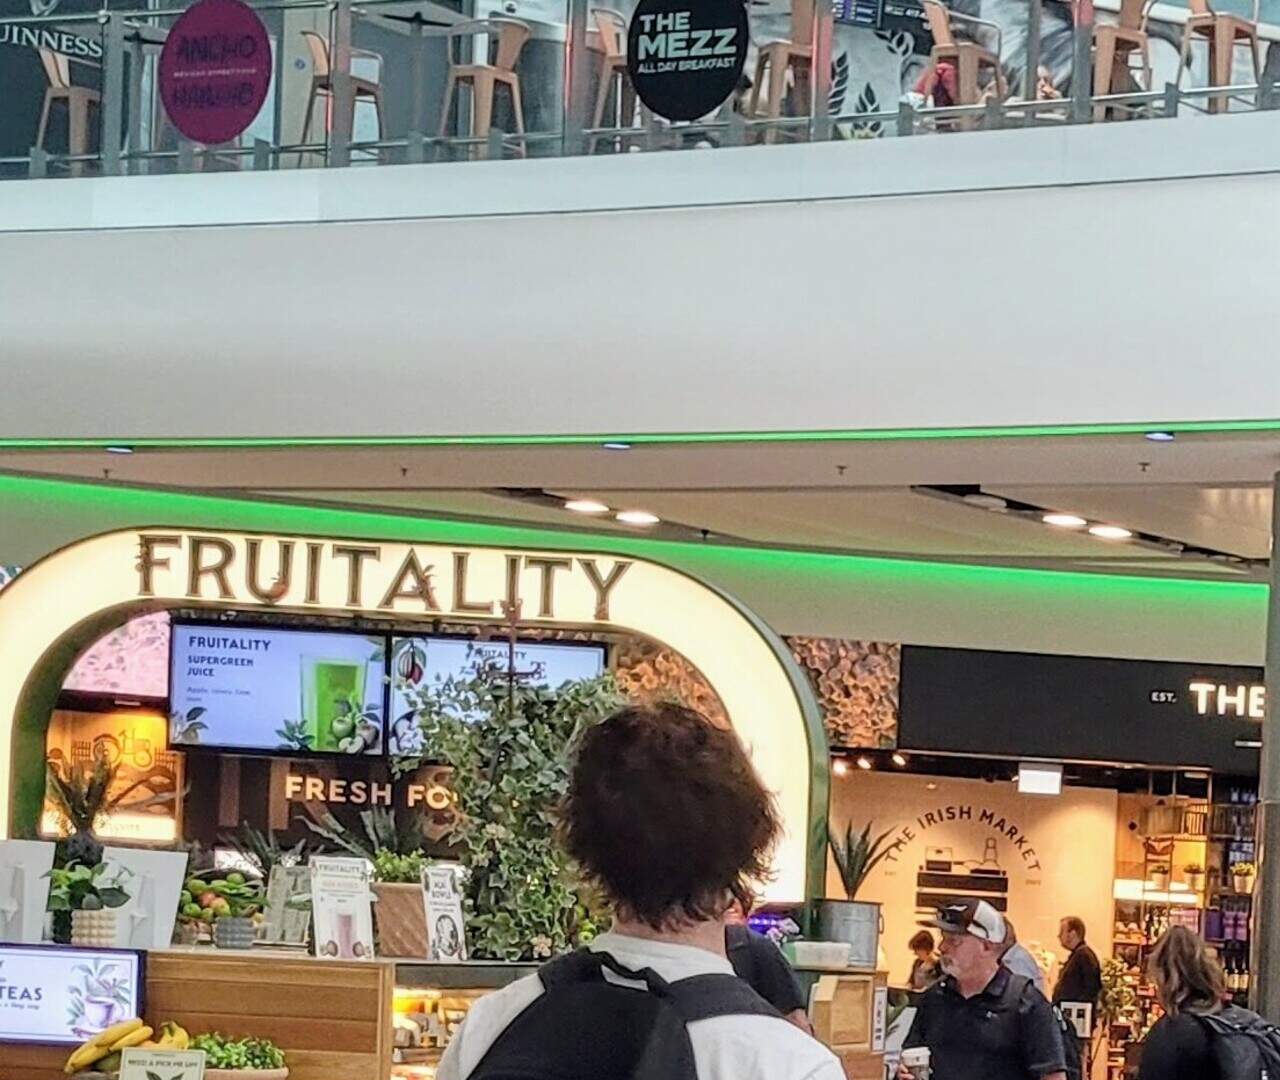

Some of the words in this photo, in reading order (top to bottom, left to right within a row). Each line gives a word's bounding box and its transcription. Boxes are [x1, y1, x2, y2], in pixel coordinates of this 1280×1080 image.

[639, 12, 691, 32] THE
[0, 24, 103, 58] UINNESS
[638, 28, 737, 60] MEZZ
[638, 61, 656, 74] ALL
[658, 59, 677, 72] DAY
[678, 57, 736, 71] BREAKFAST
[135, 534, 636, 621] FRUITALITY
[189, 636, 271, 651] FRUITALITY
[187, 667, 215, 677] JUICE
[188, 655, 254, 667] SUPERGREEN
[1151, 692, 1177, 703] EST.
[1189, 683, 1266, 718] THE
[285, 776, 392, 806] FRESH
[407, 784, 458, 810] FO
[885, 826, 916, 862] THE
[917, 806, 972, 829] IRISH
[979, 809, 1041, 871] MARKET
